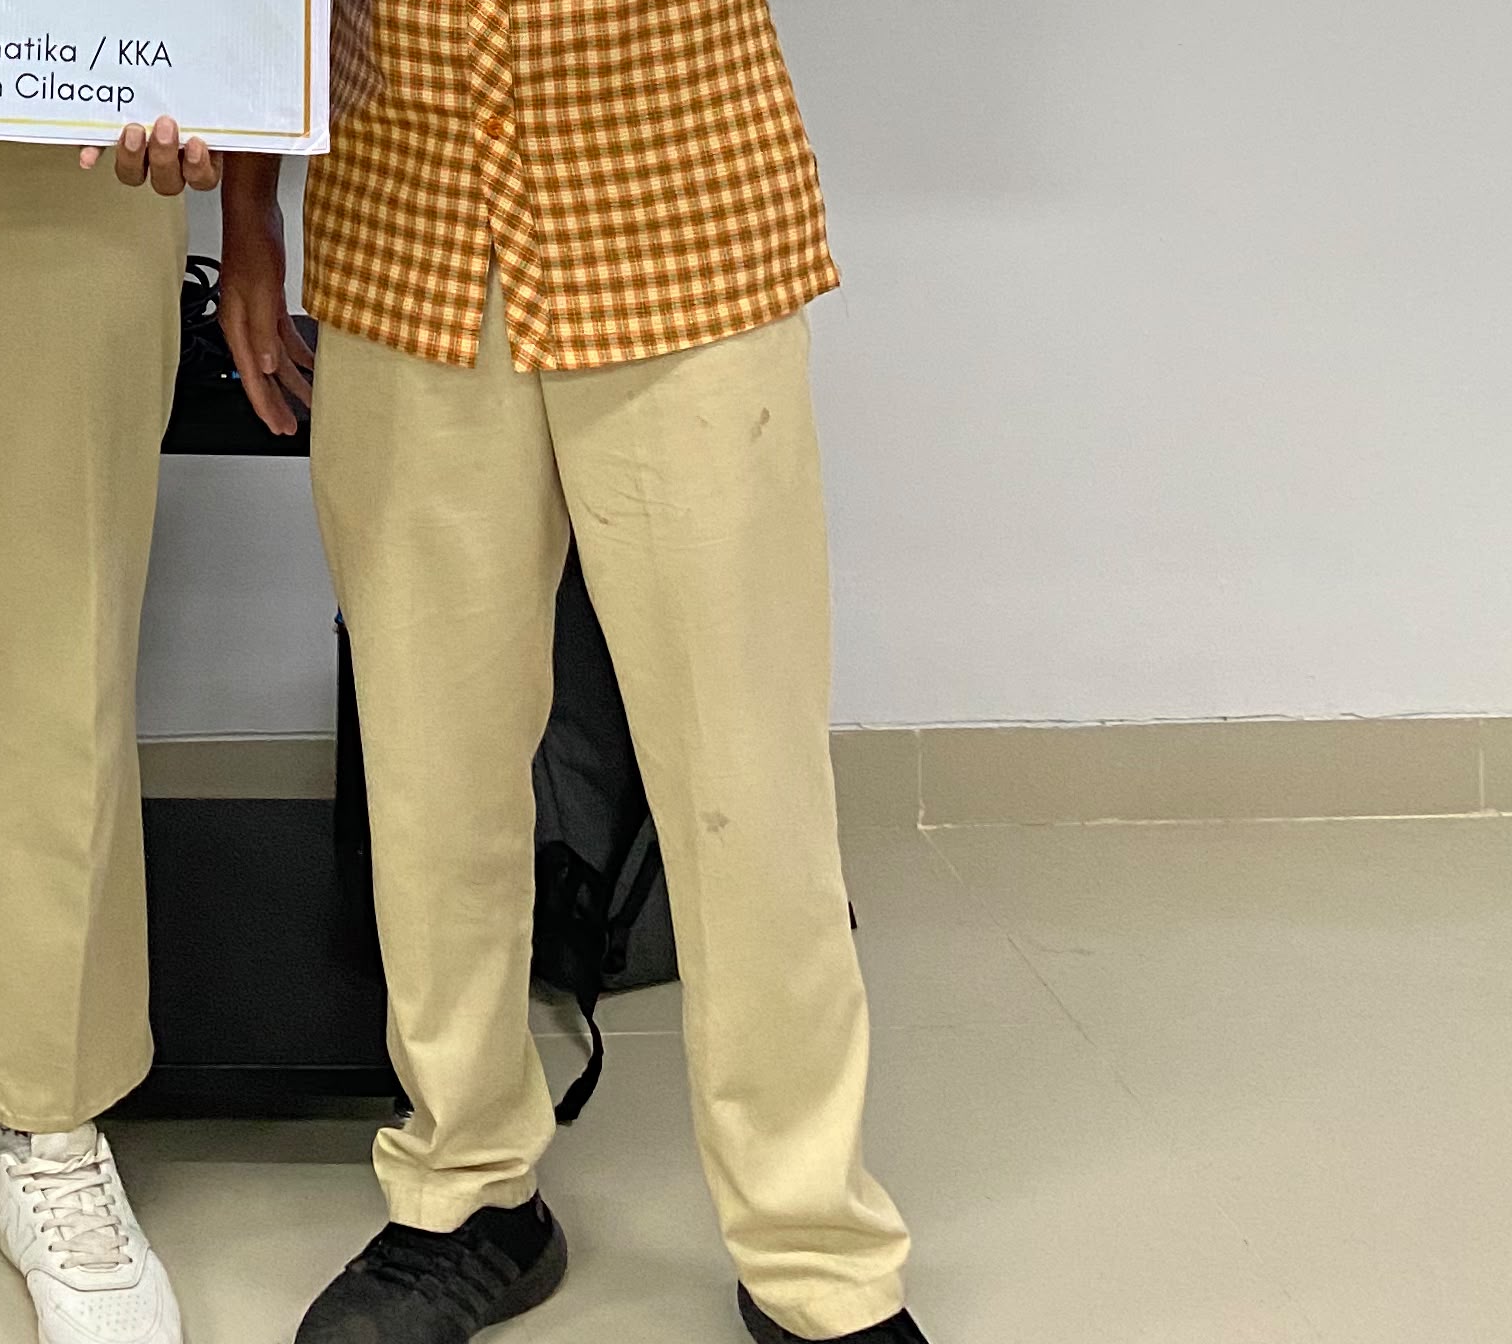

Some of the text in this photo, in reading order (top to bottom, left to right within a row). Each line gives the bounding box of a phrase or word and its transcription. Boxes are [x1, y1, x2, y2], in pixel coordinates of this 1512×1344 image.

[89, 36, 107, 71] /
[118, 39, 173, 68] KKA
[15, 72, 135, 112] Cilacap
